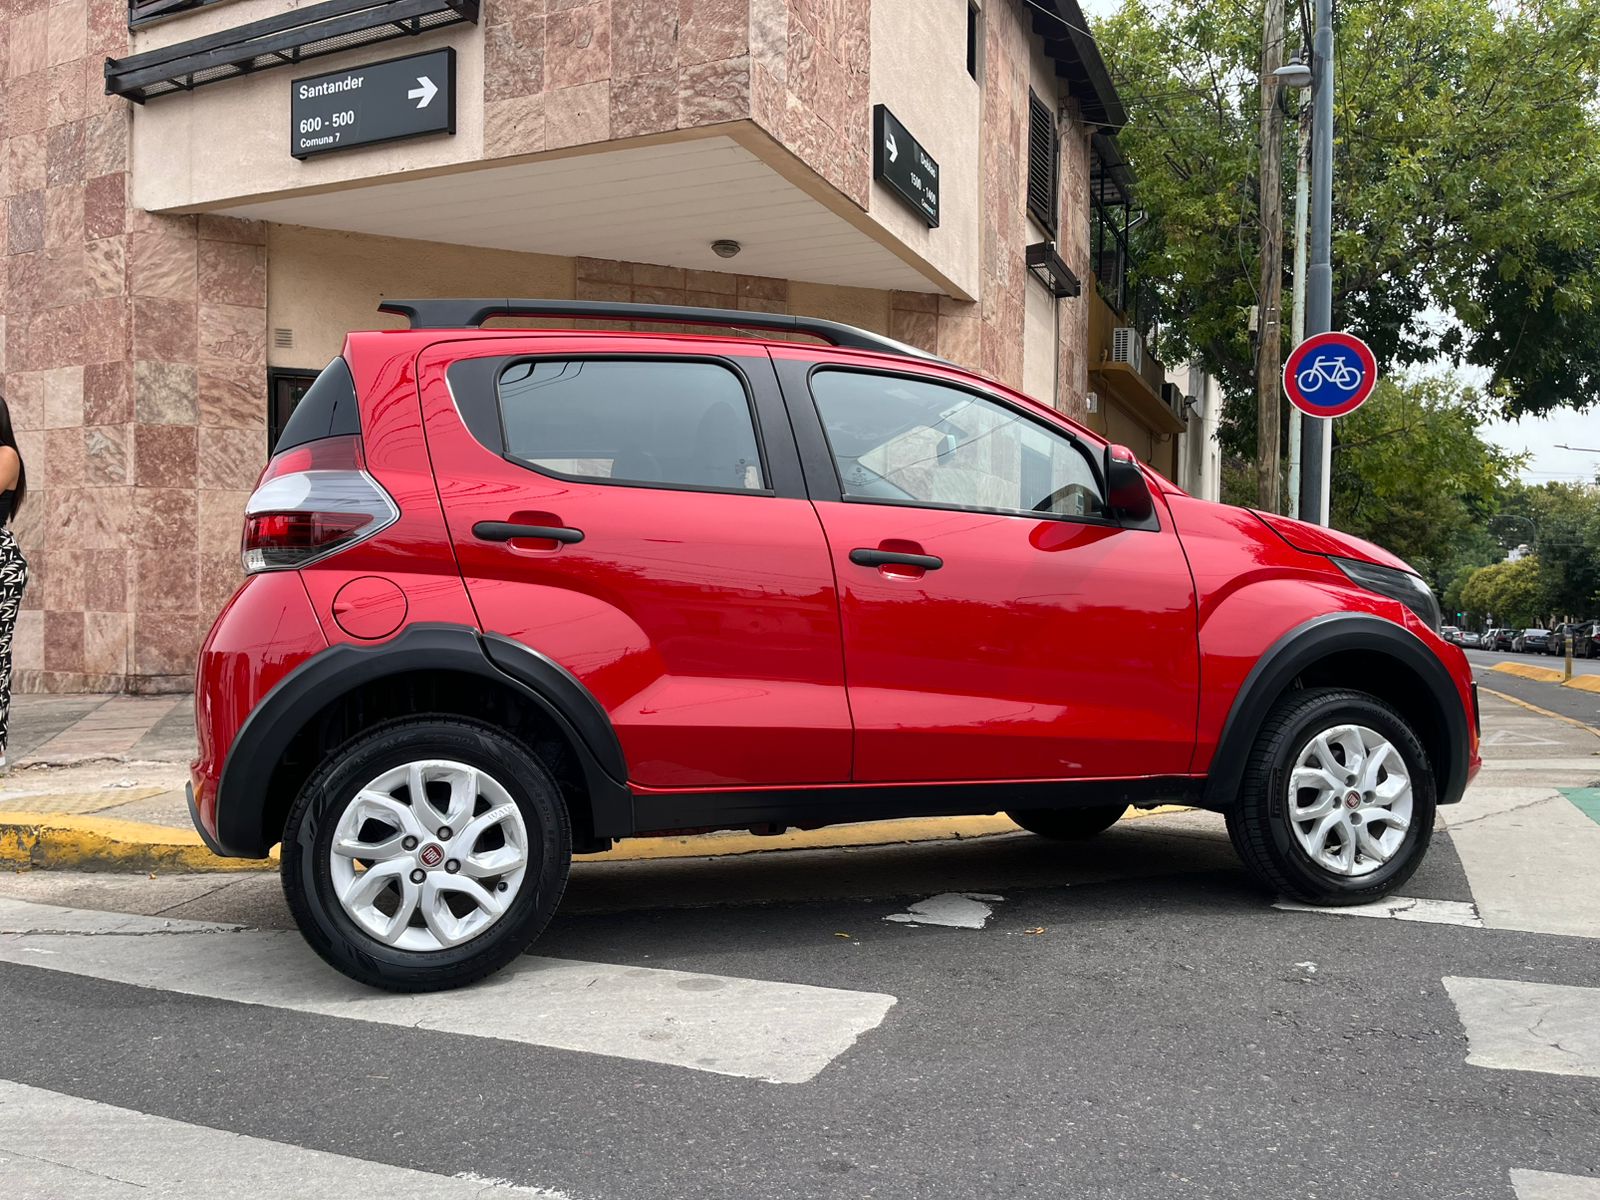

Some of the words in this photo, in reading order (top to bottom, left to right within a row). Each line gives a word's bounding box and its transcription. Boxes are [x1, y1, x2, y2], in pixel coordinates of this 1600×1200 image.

[299, 76, 364, 100] Santander
[300, 116, 322, 134] 600
[332, 110, 355, 128] 500
[300, 134, 334, 148] Comuna
[335, 133, 341, 142] 7
[423, 847, 440, 863] FIAT
